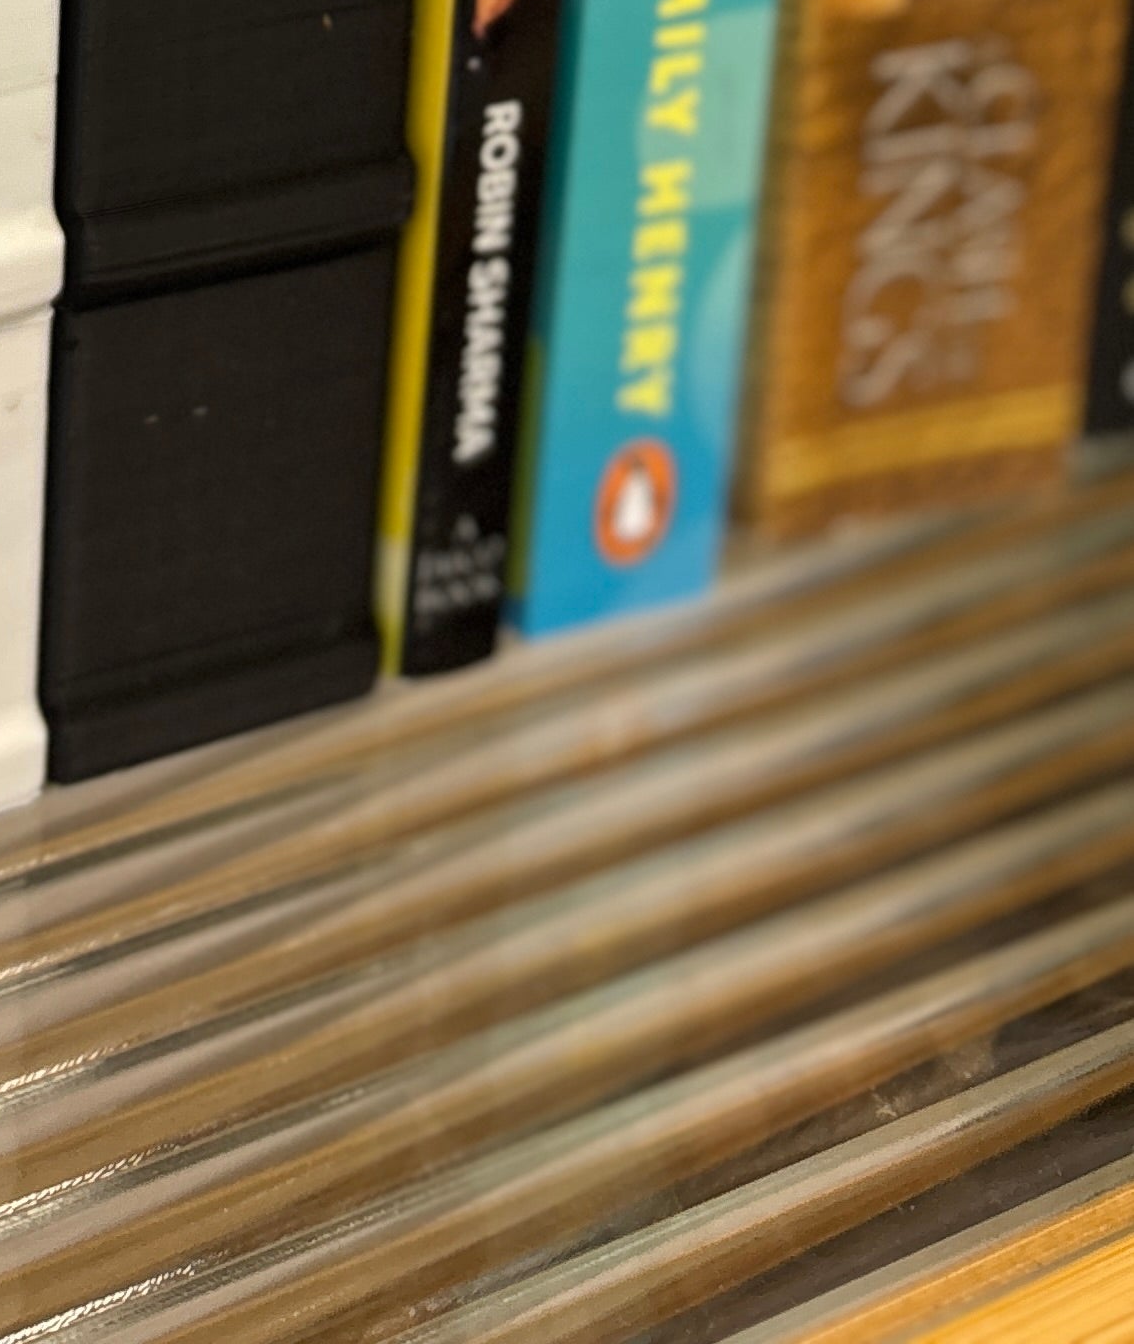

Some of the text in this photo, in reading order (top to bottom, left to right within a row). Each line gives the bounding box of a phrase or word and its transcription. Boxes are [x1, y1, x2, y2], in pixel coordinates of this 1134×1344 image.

[474, 99, 521, 253] ROBIN
[452, 258, 510, 464] SHARMA
[616, 159, 692, 416] HENRY
